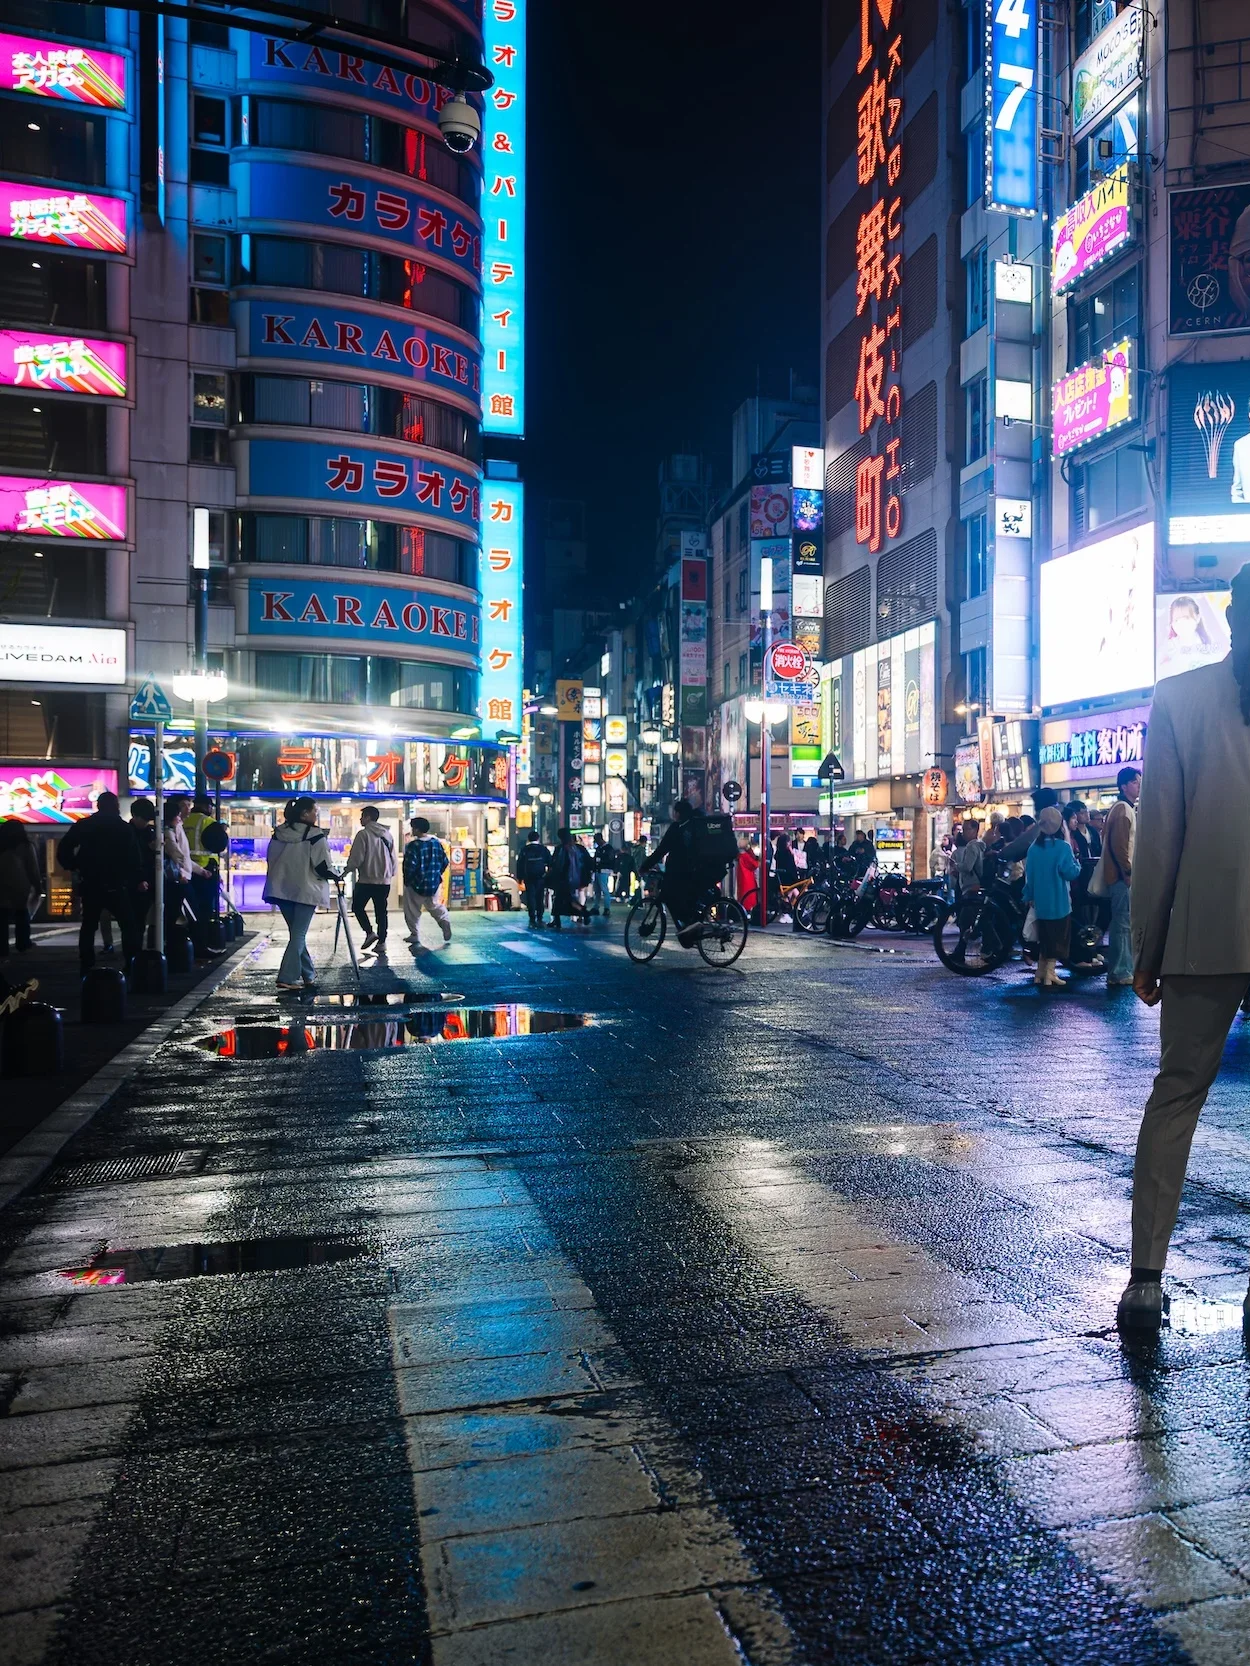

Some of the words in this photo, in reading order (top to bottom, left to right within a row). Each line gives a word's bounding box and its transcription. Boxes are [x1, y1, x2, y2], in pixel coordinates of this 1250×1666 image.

[262, 37, 455, 112] KARAOK
[1065, 169, 1128, 240] 高収入バイト
[855, 68, 887, 554] 歌舞伎町
[1186, 315, 1221, 328] CERN
[262, 314, 469, 385] KARAOKE
[261, 591, 469, 641] KARAOKE
[488, 500, 514, 722] カラオケ館
[774, 653, 803, 670] 消火栓
[1069, 721, 1147, 768] 無料案内所
